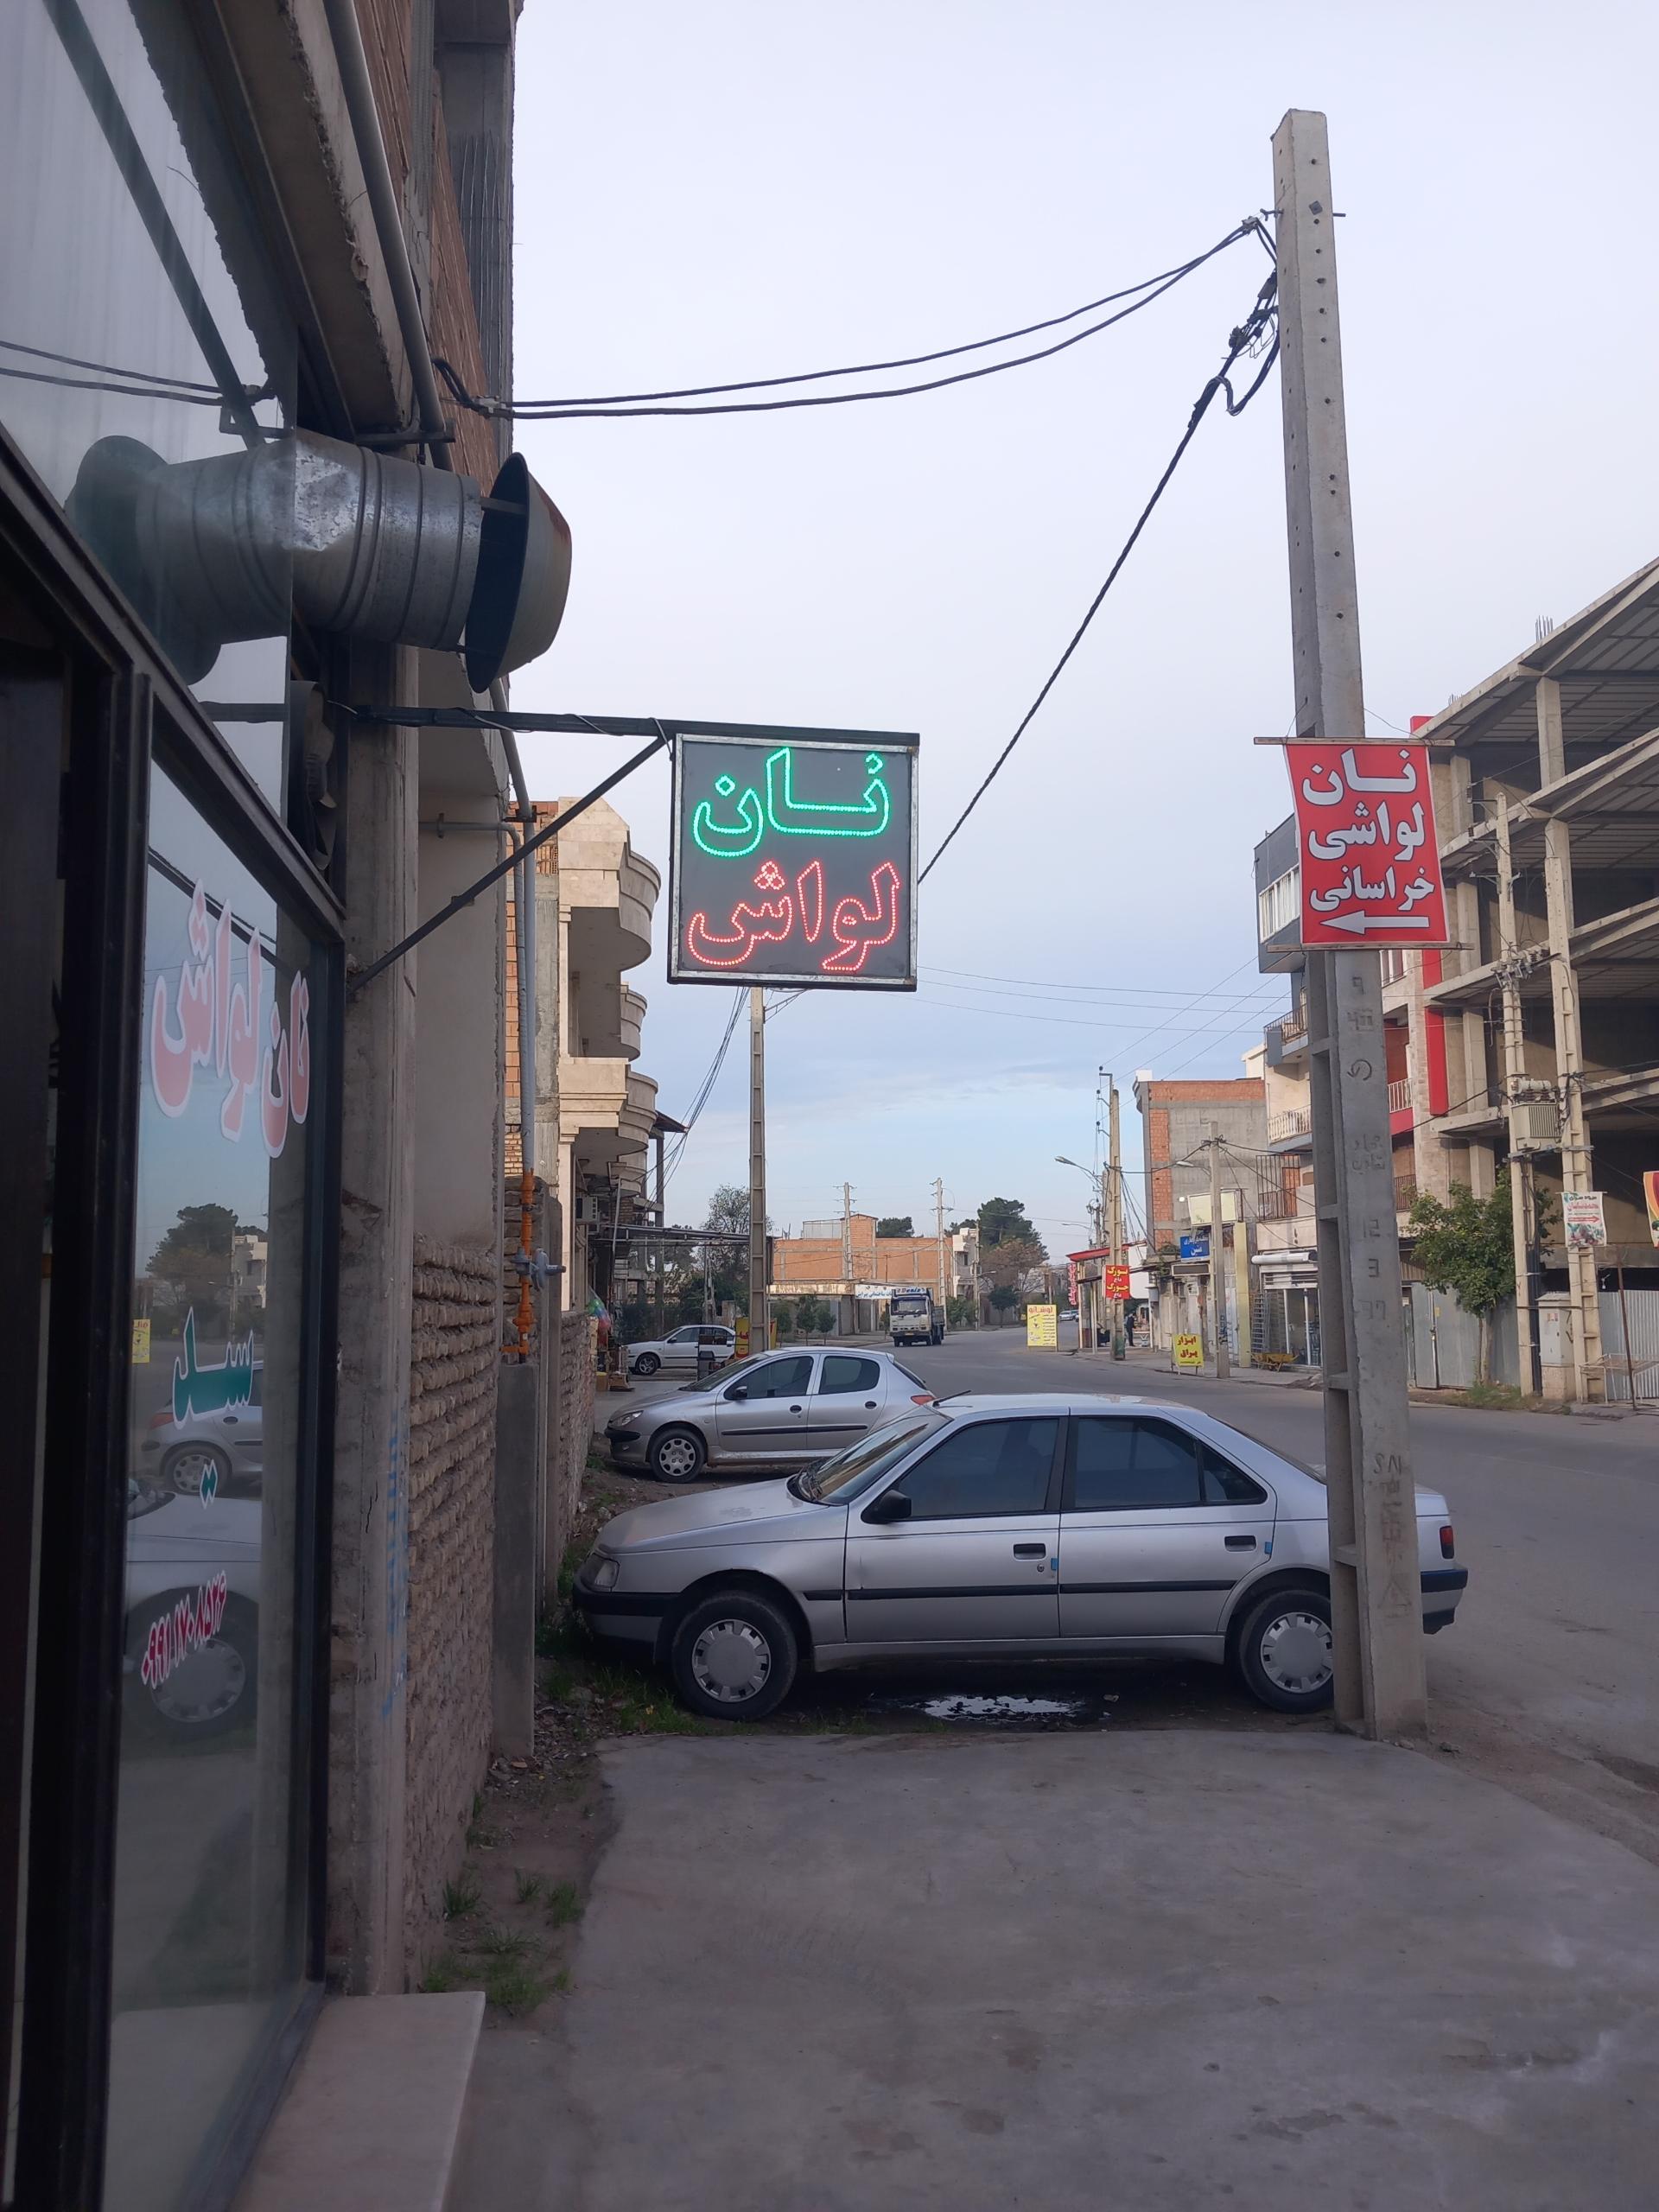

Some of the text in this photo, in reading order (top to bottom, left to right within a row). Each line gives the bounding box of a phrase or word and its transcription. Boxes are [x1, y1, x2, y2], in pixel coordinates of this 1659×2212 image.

[694, 747, 890, 856] نان
[1301, 747, 1418, 806] نان
[1307, 800, 1426, 861] لواشی
[689, 861, 899, 969] لواش
[1309, 864, 1435, 912] خراسانی
[150, 877, 263, 1143] لواش
